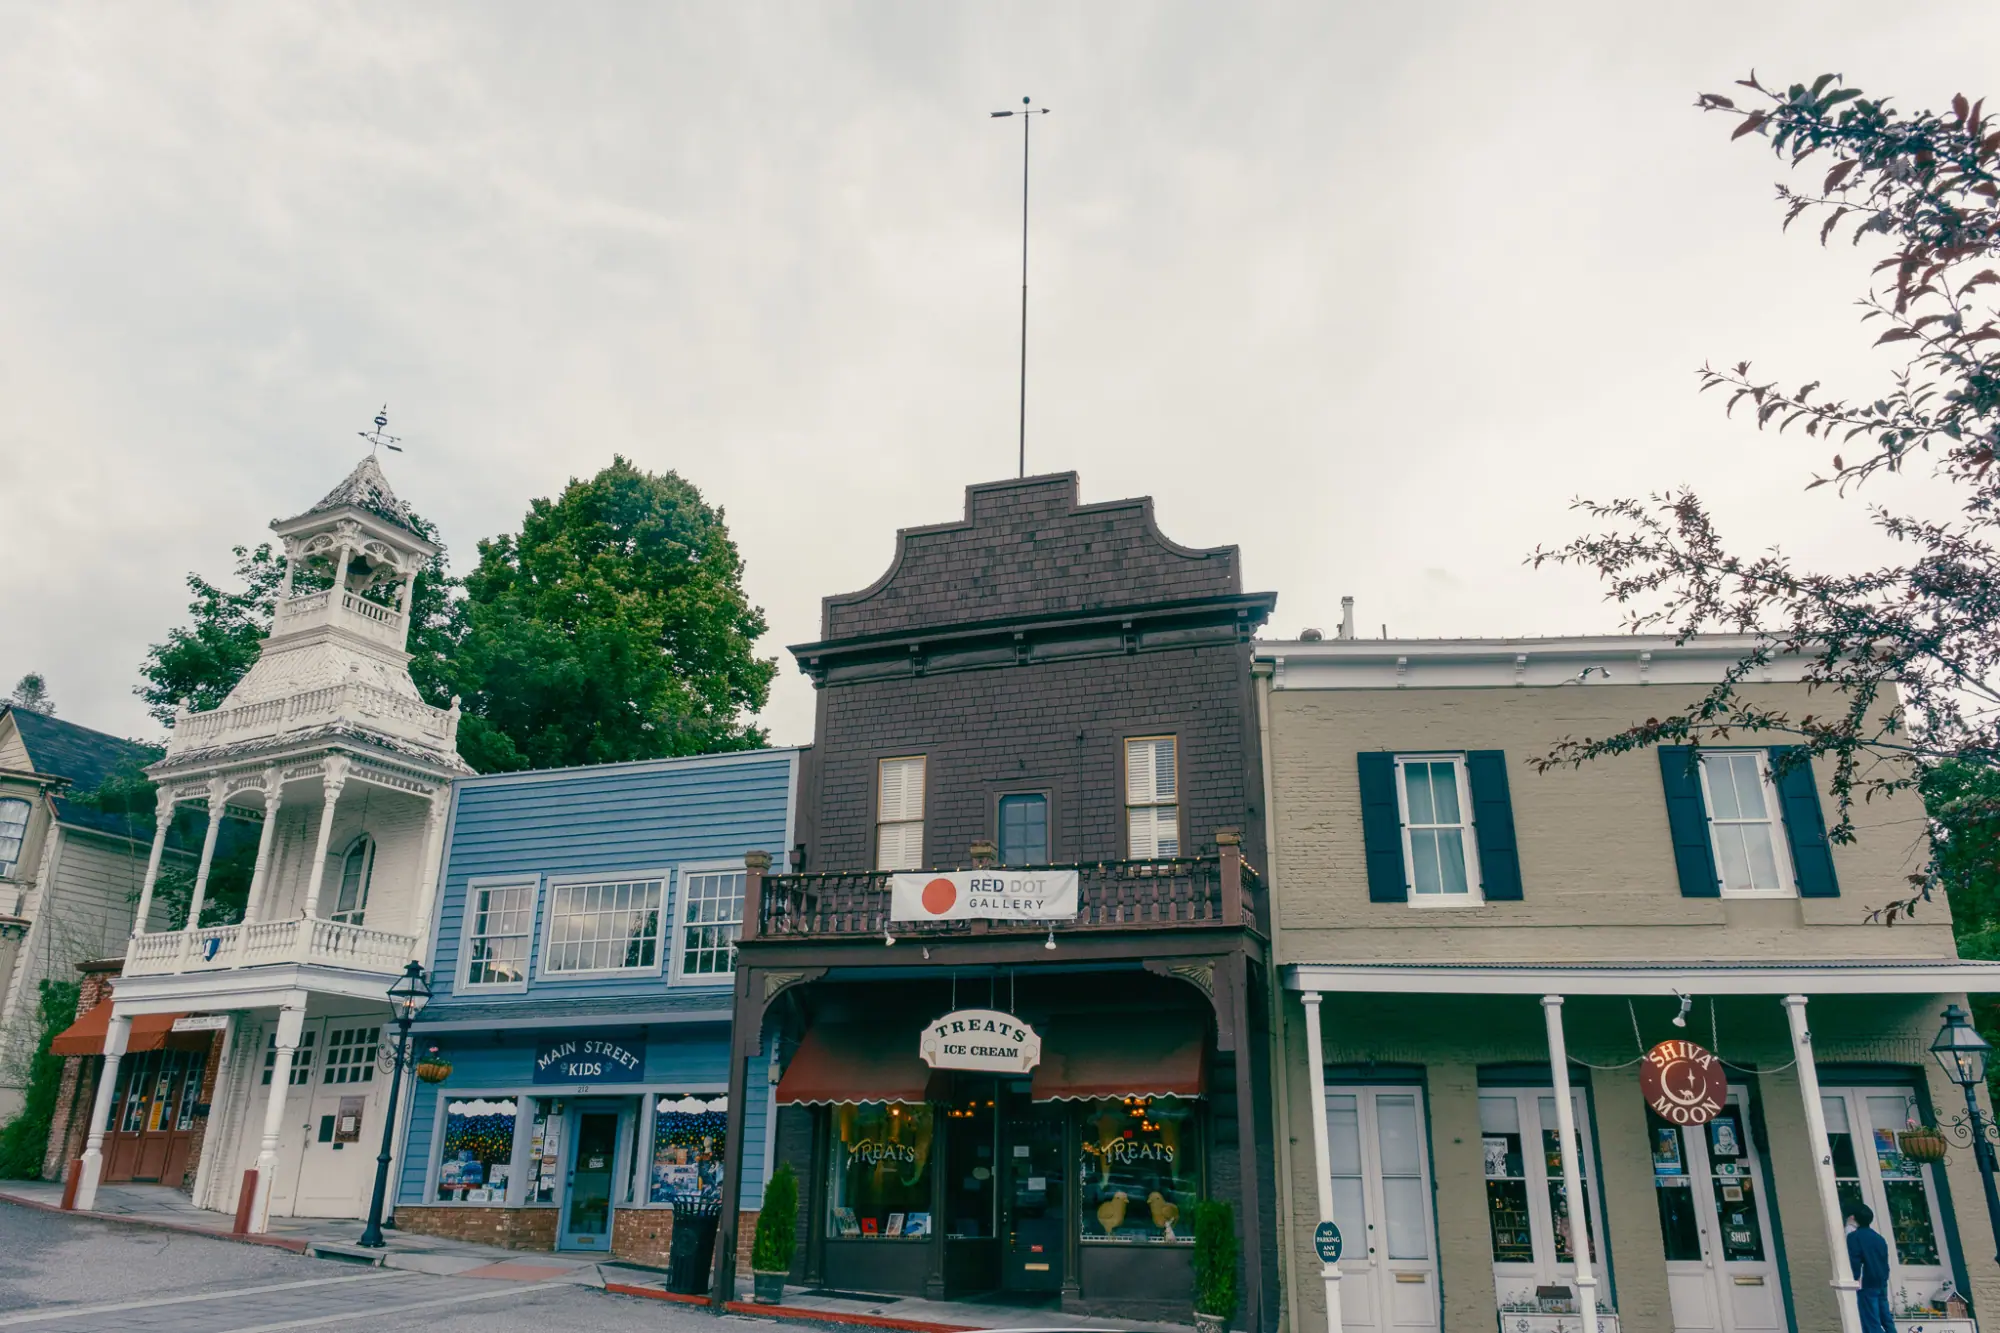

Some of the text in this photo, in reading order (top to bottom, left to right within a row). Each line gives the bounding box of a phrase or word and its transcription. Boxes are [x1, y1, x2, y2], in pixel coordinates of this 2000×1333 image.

[970, 879, 1047, 894] RED DOT
[969, 898, 1044, 910] GALLERY
[935, 1019, 1028, 1043] TREATS
[537, 1040, 639, 1071] MAIN STREET
[943, 1044, 1019, 1058] ICE CREAM
[1649, 1041, 1712, 1070] SHIVA
[568, 1062, 602, 1076] KIDS
[577, 1086, 589, 1094] 212
[1652, 1095, 1721, 1123] MOON
[849, 1138, 915, 1165] TREATS
[1101, 1136, 1175, 1165] TREATS
[1731, 1231, 1751, 1242] SHUT
